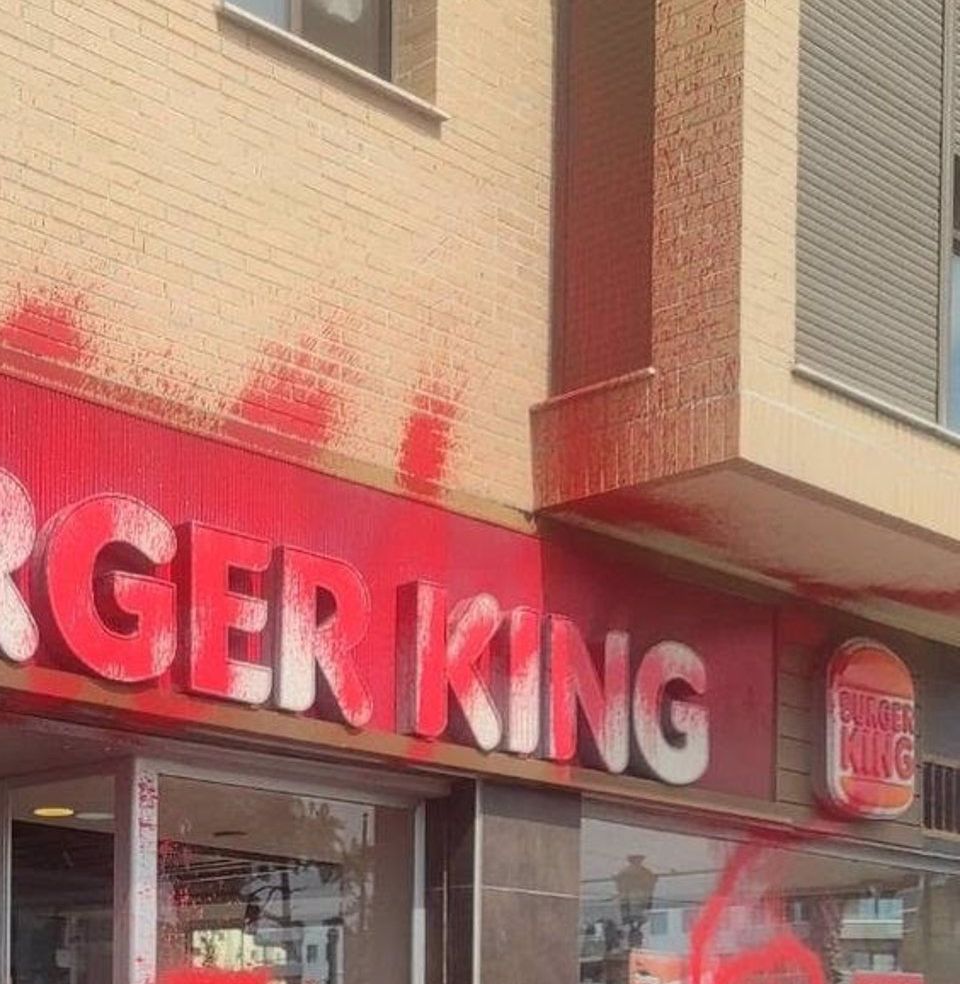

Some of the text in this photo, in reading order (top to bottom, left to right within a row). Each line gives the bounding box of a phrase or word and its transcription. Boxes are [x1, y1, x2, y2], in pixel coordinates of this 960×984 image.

[412, 577, 710, 786] KING
[839, 690, 914, 735] BURGER
[840, 725, 914, 779] KING
